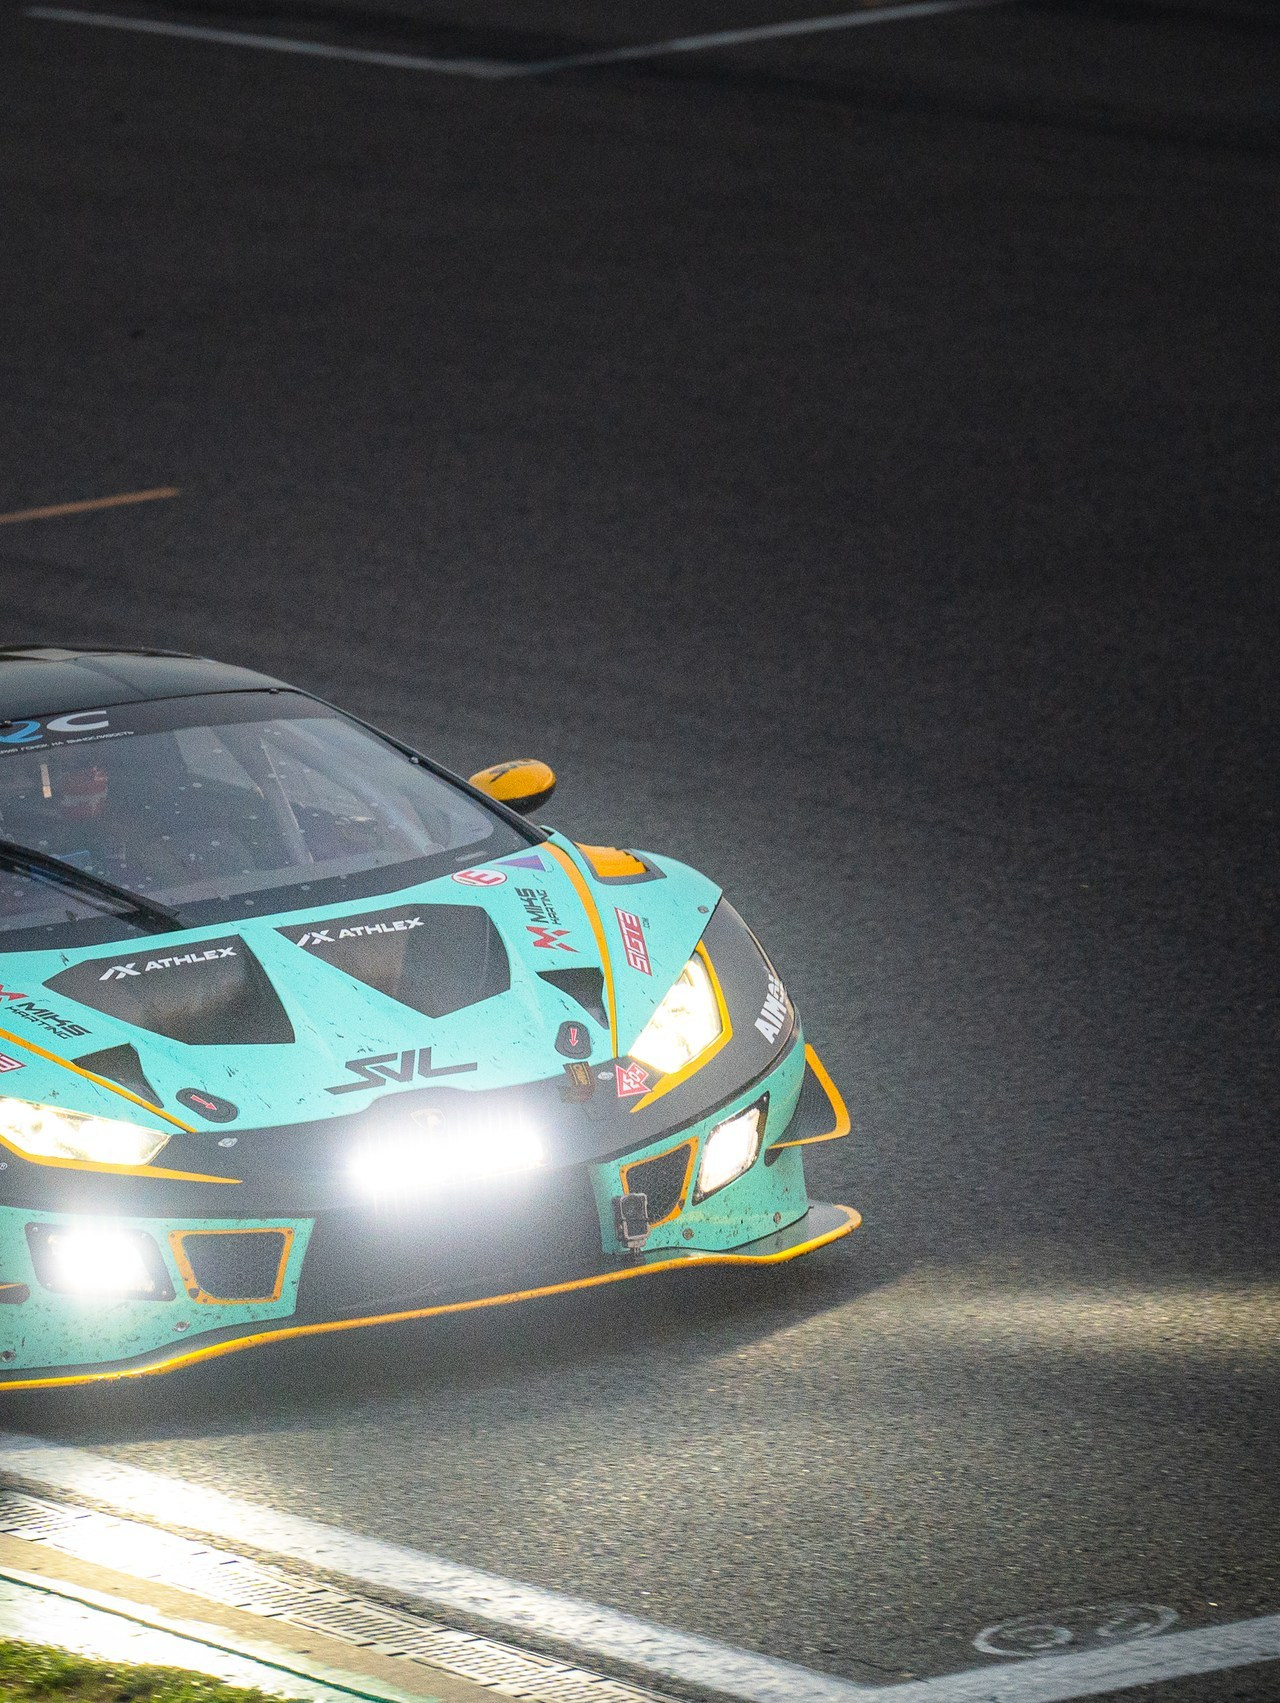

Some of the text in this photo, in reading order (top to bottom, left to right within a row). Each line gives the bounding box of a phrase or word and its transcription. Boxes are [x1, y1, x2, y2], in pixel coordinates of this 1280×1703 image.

[338, 917, 425, 940] ATHLEX
[144, 946, 237, 972] ATHLEX
[4, 1006, 74, 1040] KARTING
[15, 1002, 94, 1036] MIKS
[323, 1046, 479, 1096] SVL
